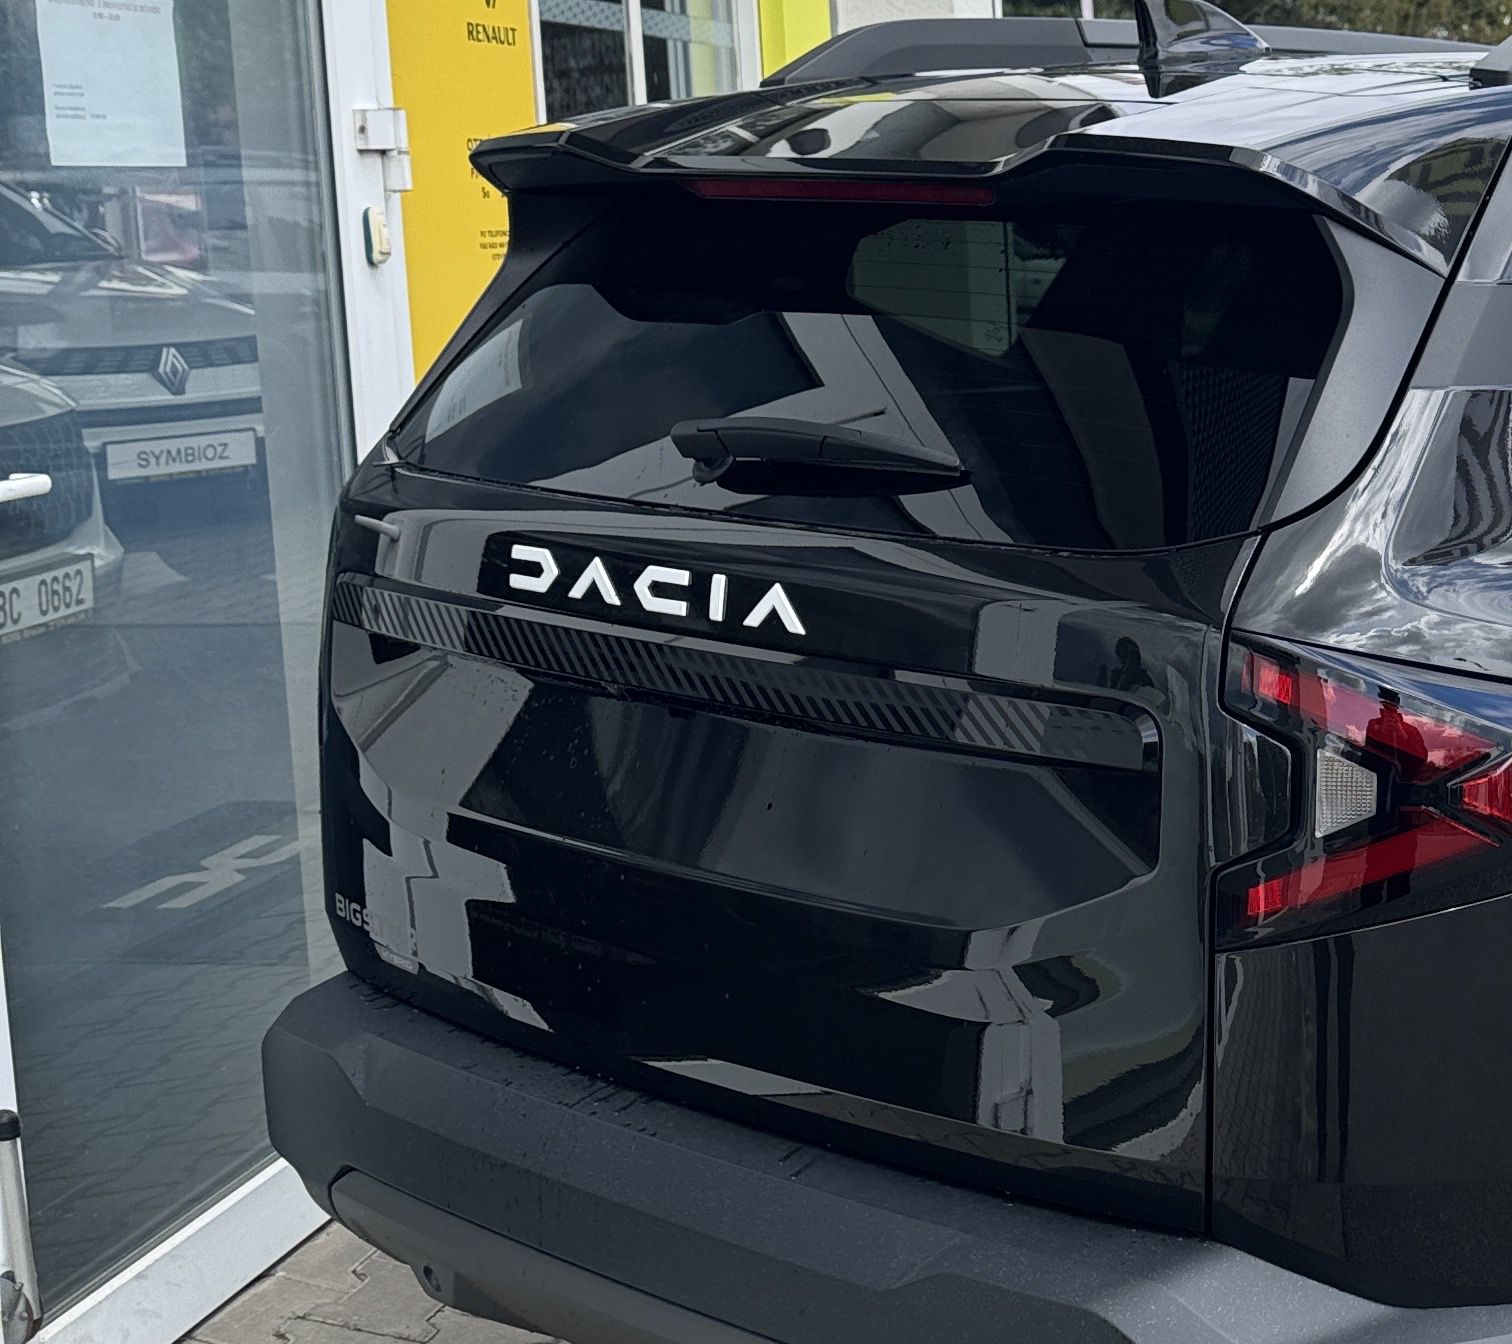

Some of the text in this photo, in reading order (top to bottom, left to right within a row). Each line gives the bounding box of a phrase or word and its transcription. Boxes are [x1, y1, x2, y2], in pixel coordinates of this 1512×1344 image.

[466, 21, 517, 46] RENAULT
[137, 442, 230, 468] SYMBIOZ
[38, 568, 85, 617] 0662
[509, 544, 806, 636] DACIA
